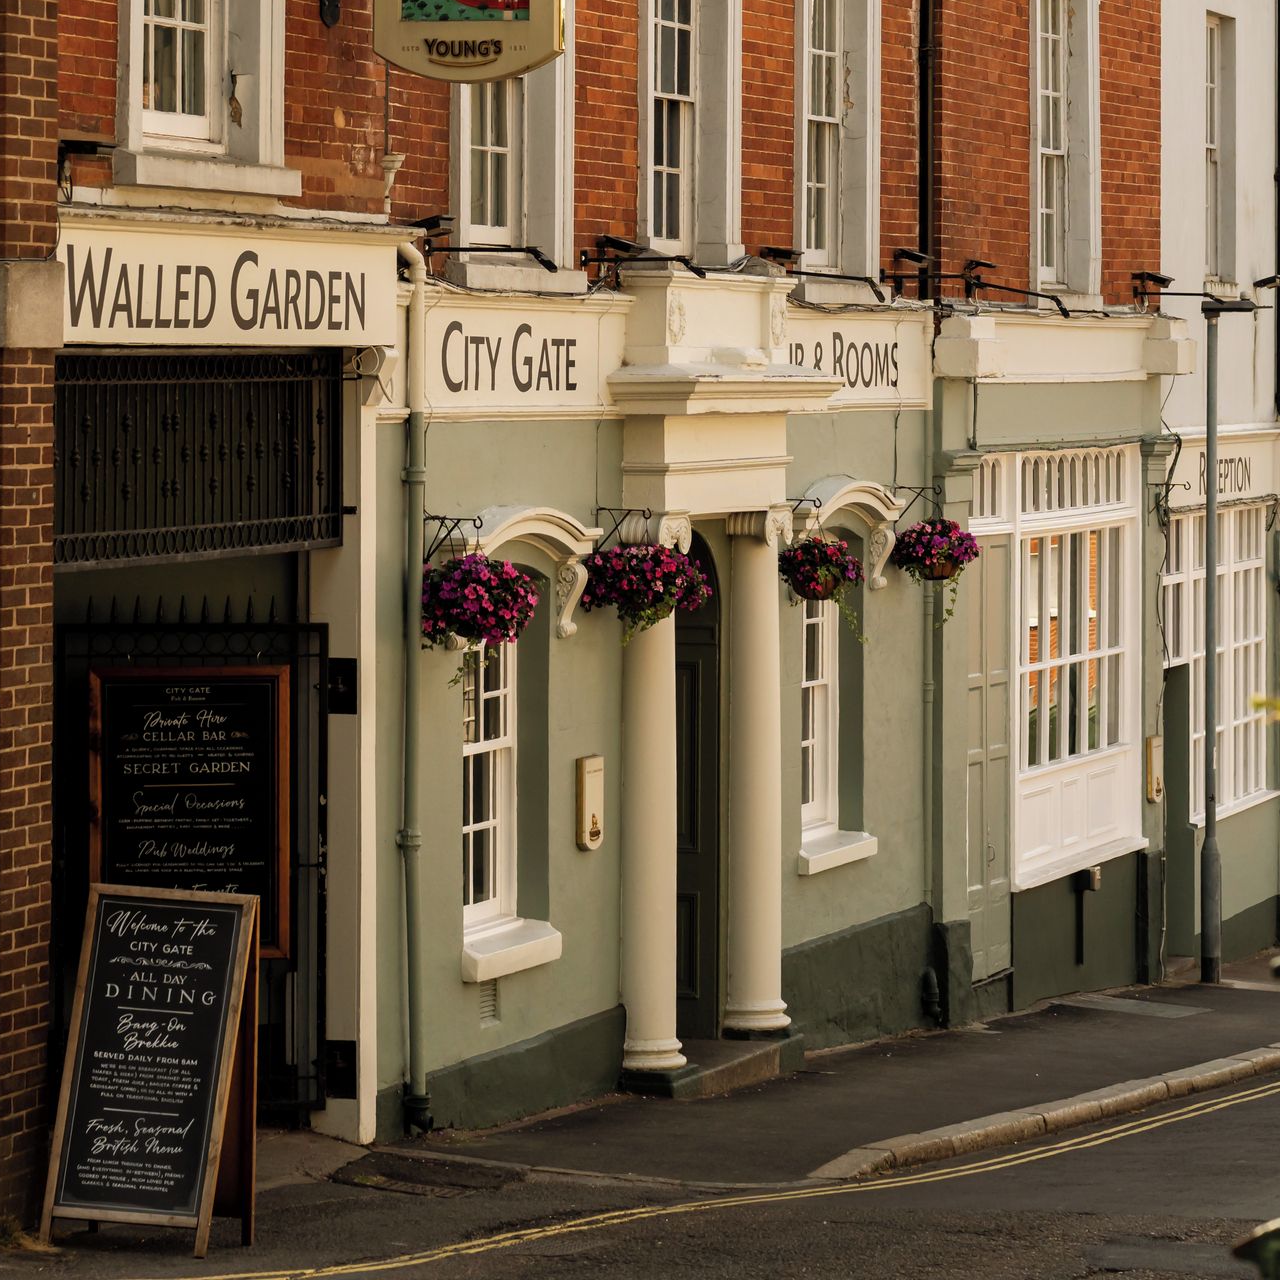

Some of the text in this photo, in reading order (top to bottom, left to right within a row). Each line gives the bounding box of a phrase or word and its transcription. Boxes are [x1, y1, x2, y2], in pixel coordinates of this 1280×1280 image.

[424, 38, 503, 58] YOUNG'S
[66, 244, 366, 332] WALLED GARDEN
[441, 320, 578, 393] CITY GATE
[832, 332, 898, 388] ROOMS
[1199, 451, 1251, 496] REPTION
[144, 709, 228, 730] Private Hire
[143, 730, 227, 742] CELLAR BAR
[123, 761, 250, 774] SECRET GARDEN
[132, 790, 245, 816] Special Occasions
[138, 840, 236, 858] Pub Weddings
[106, 910, 218, 942] Welcome to the
[130, 941, 194, 956] CITY GATE
[130, 972, 188, 984] ALL DAY
[105, 984, 216, 1006] DINING
[123, 1032, 179, 1051] Brekkie
[94, 1050, 125, 1060] SERVED
[128, 1054, 154, 1062] DAILY
[156, 1056, 179, 1065] FROM
[134, 1118, 195, 1140] Seasonal
[91, 1136, 184, 1156] British Menu
